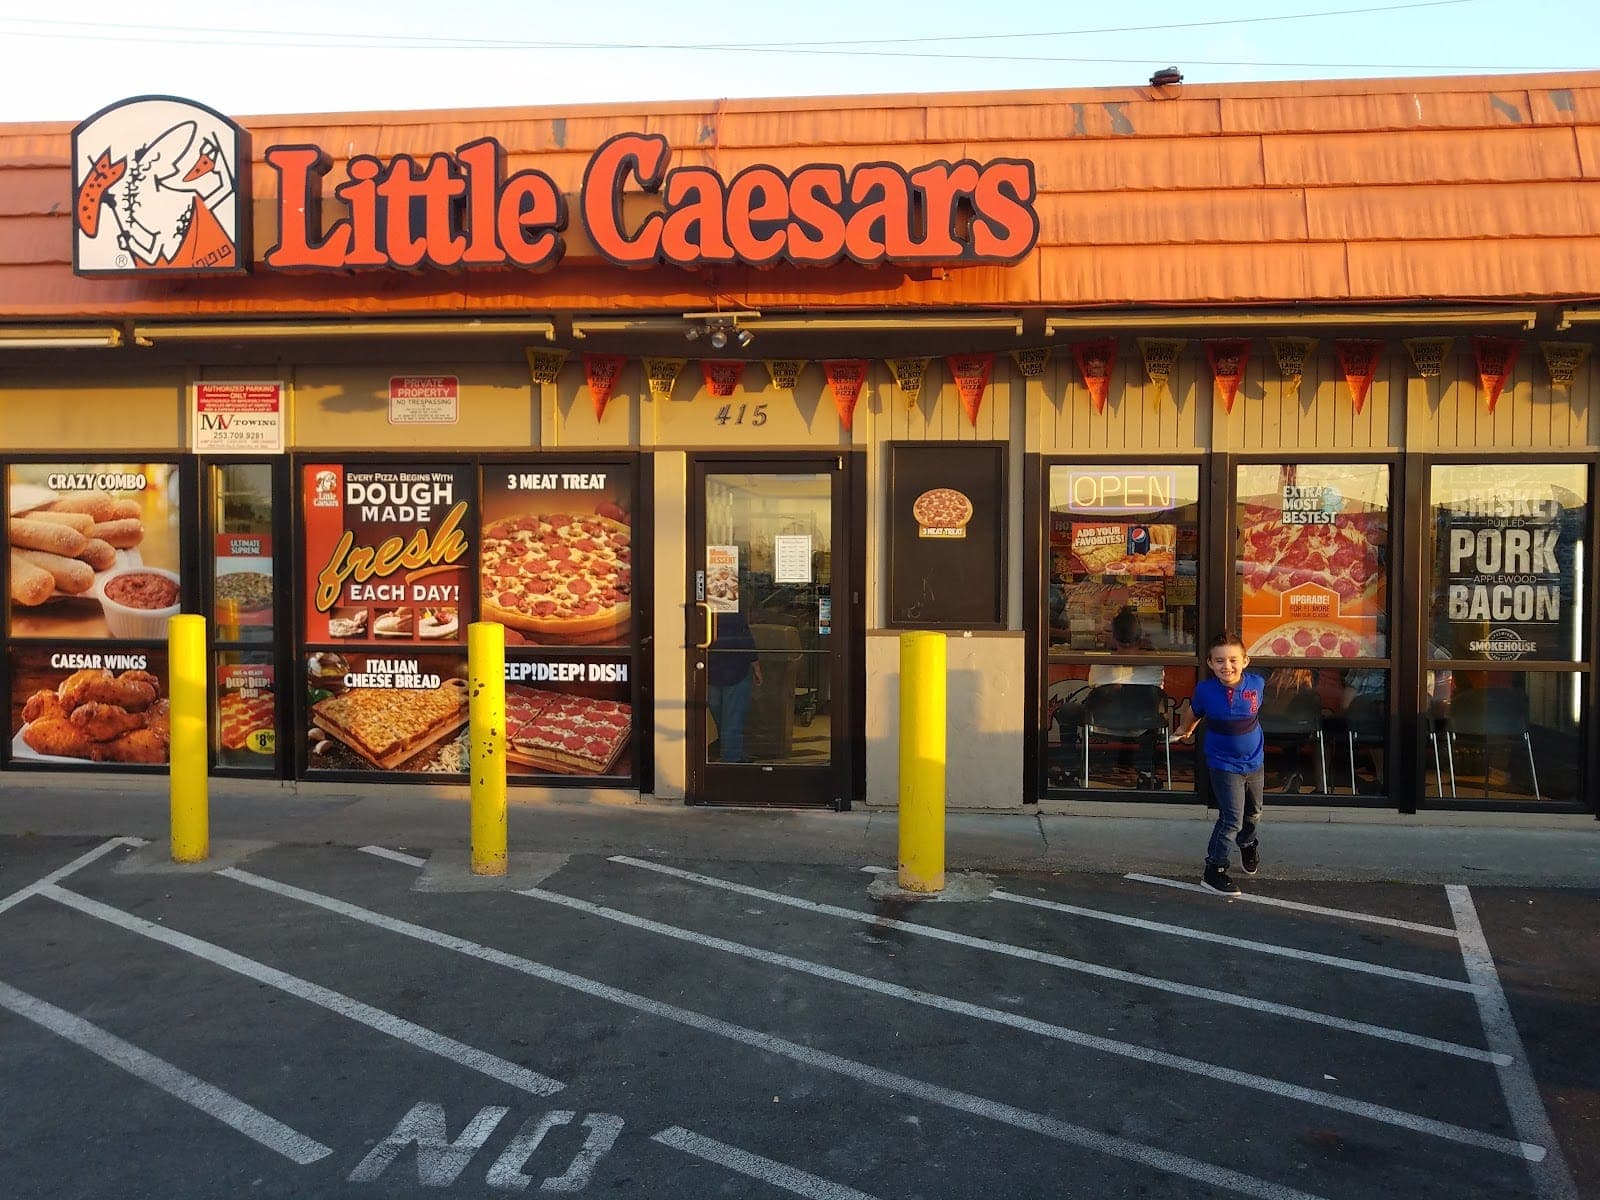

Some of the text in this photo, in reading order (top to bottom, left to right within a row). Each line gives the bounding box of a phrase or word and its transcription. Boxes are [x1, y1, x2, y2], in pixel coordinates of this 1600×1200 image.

[265, 133, 1039, 269] Little Caesars
[404, 378, 445, 388] PRIVATE
[398, 388, 450, 397] PROPERTY
[200, 414, 234, 430] MV
[714, 404, 768, 427] 415
[48, 474, 146, 490] CRAZY COMBO
[346, 473, 454, 481] EVERY PIZZA BEGINS WITH
[507, 474, 606, 490] 3 MEAT TREAT
[347, 483, 453, 505] DOUGH
[1074, 475, 1171, 508] OPEN
[1283, 486, 1322, 498] EXTRA
[1283, 498, 1318, 511] MOST
[362, 506, 430, 522] MADE
[1283, 512, 1337, 524] BESTEST
[1487, 519, 1525, 527] PULLED
[1075, 534, 1124, 546] FAVORITES!
[1077, 526, 1121, 538] ADD YOUR
[316, 501, 468, 612] fresh
[1450, 528, 1561, 574] PORK
[1472, 575, 1537, 583] APPLEWOOD
[350, 585, 460, 601] EACH DAY!
[1290, 595, 1330, 605] UPGRADE!
[1448, 584, 1560, 621] BACON
[1469, 640, 1537, 652] SMOKEHOUSE
[51, 654, 147, 670] CAESAR WINGS
[366, 660, 418, 674] ITALIAN
[588, 663, 628, 681] DISH
[344, 674, 441, 689] CHEESE BREAD
[346, 1101, 625, 1192] NO
